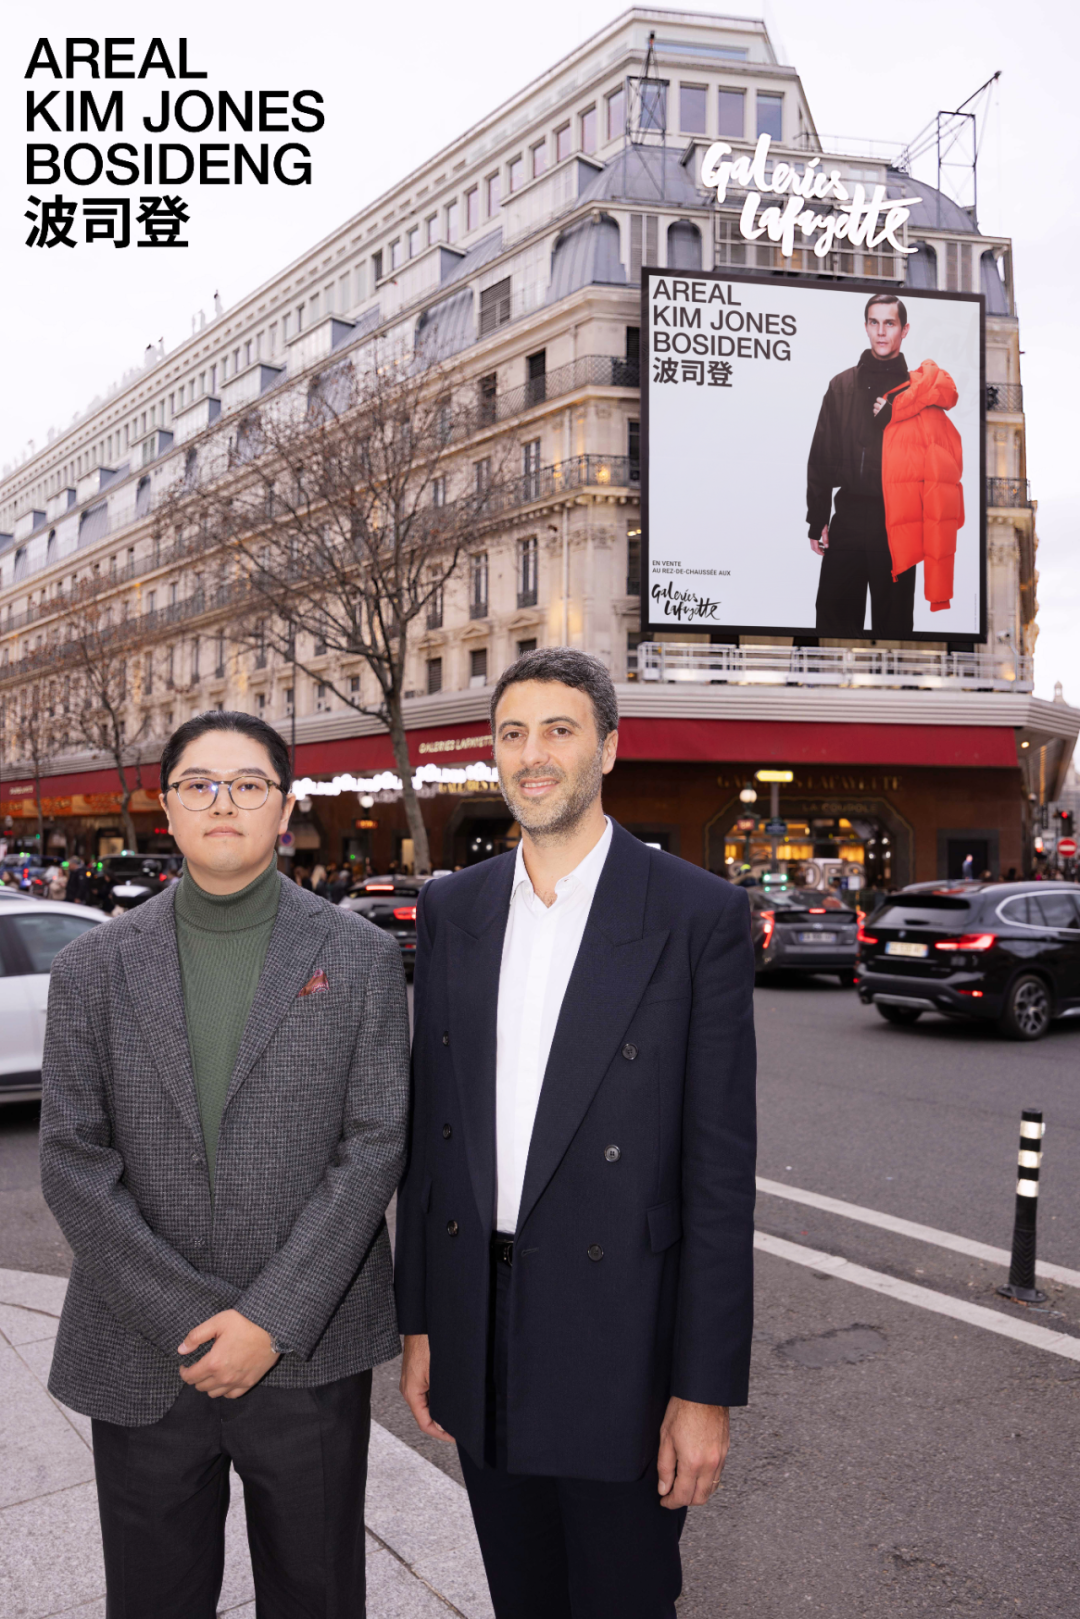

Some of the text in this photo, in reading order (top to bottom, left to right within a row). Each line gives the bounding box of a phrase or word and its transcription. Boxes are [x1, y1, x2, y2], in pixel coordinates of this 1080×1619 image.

[701, 132, 850, 204] Galeries
[739, 183, 923, 258] Lafayette
[652, 279, 742, 306] AREAL
[653, 304, 798, 337] KIM JONES
[653, 331, 792, 361] BOSIDENG
[652, 356, 734, 388] 波司登
[651, 581, 698, 604] Galeries
[664, 597, 721, 621] Lafayette
[418, 734, 493, 754] GALERIES LAFAYETT
